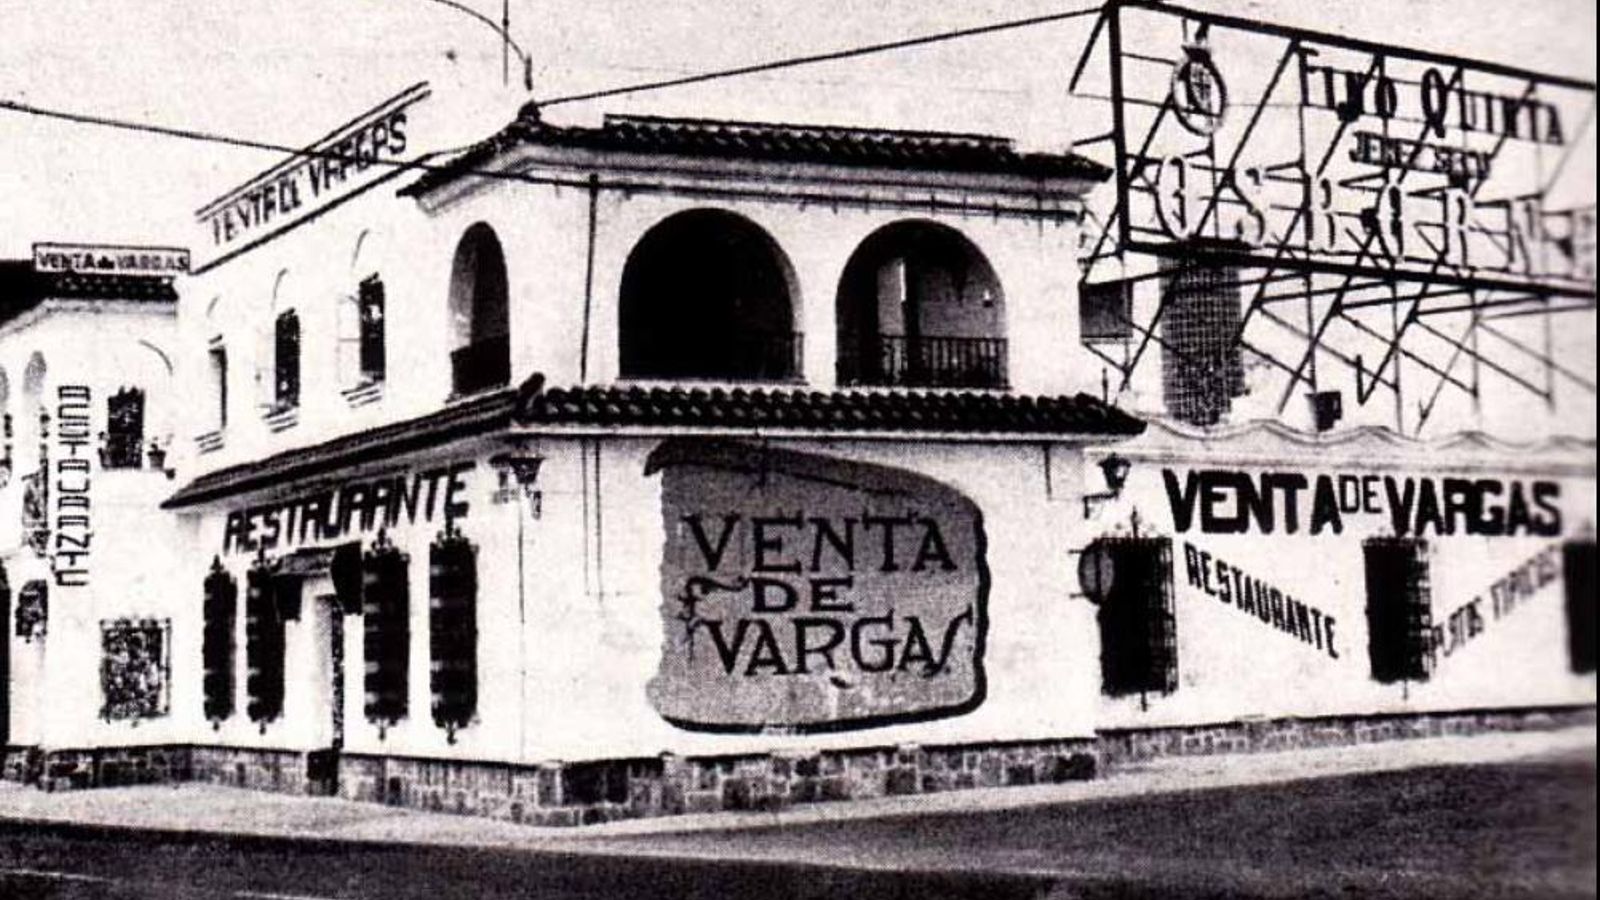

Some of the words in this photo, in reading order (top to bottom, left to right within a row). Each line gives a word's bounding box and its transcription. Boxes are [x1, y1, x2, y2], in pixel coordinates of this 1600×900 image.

[37, 252, 95, 269] VENTA
[116, 254, 189, 271] VARGAS
[223, 460, 476, 556] RESTAURANTE
[1162, 468, 1343, 535] VENTA
[1339, 475, 1384, 514] DE
[1384, 475, 1562, 537] VARGAS
[681, 507, 957, 573] VENTA
[750, 576, 855, 613] DE
[1184, 541, 1339, 660] RESTAURANTE
[694, 606, 974, 678] VARGAS
